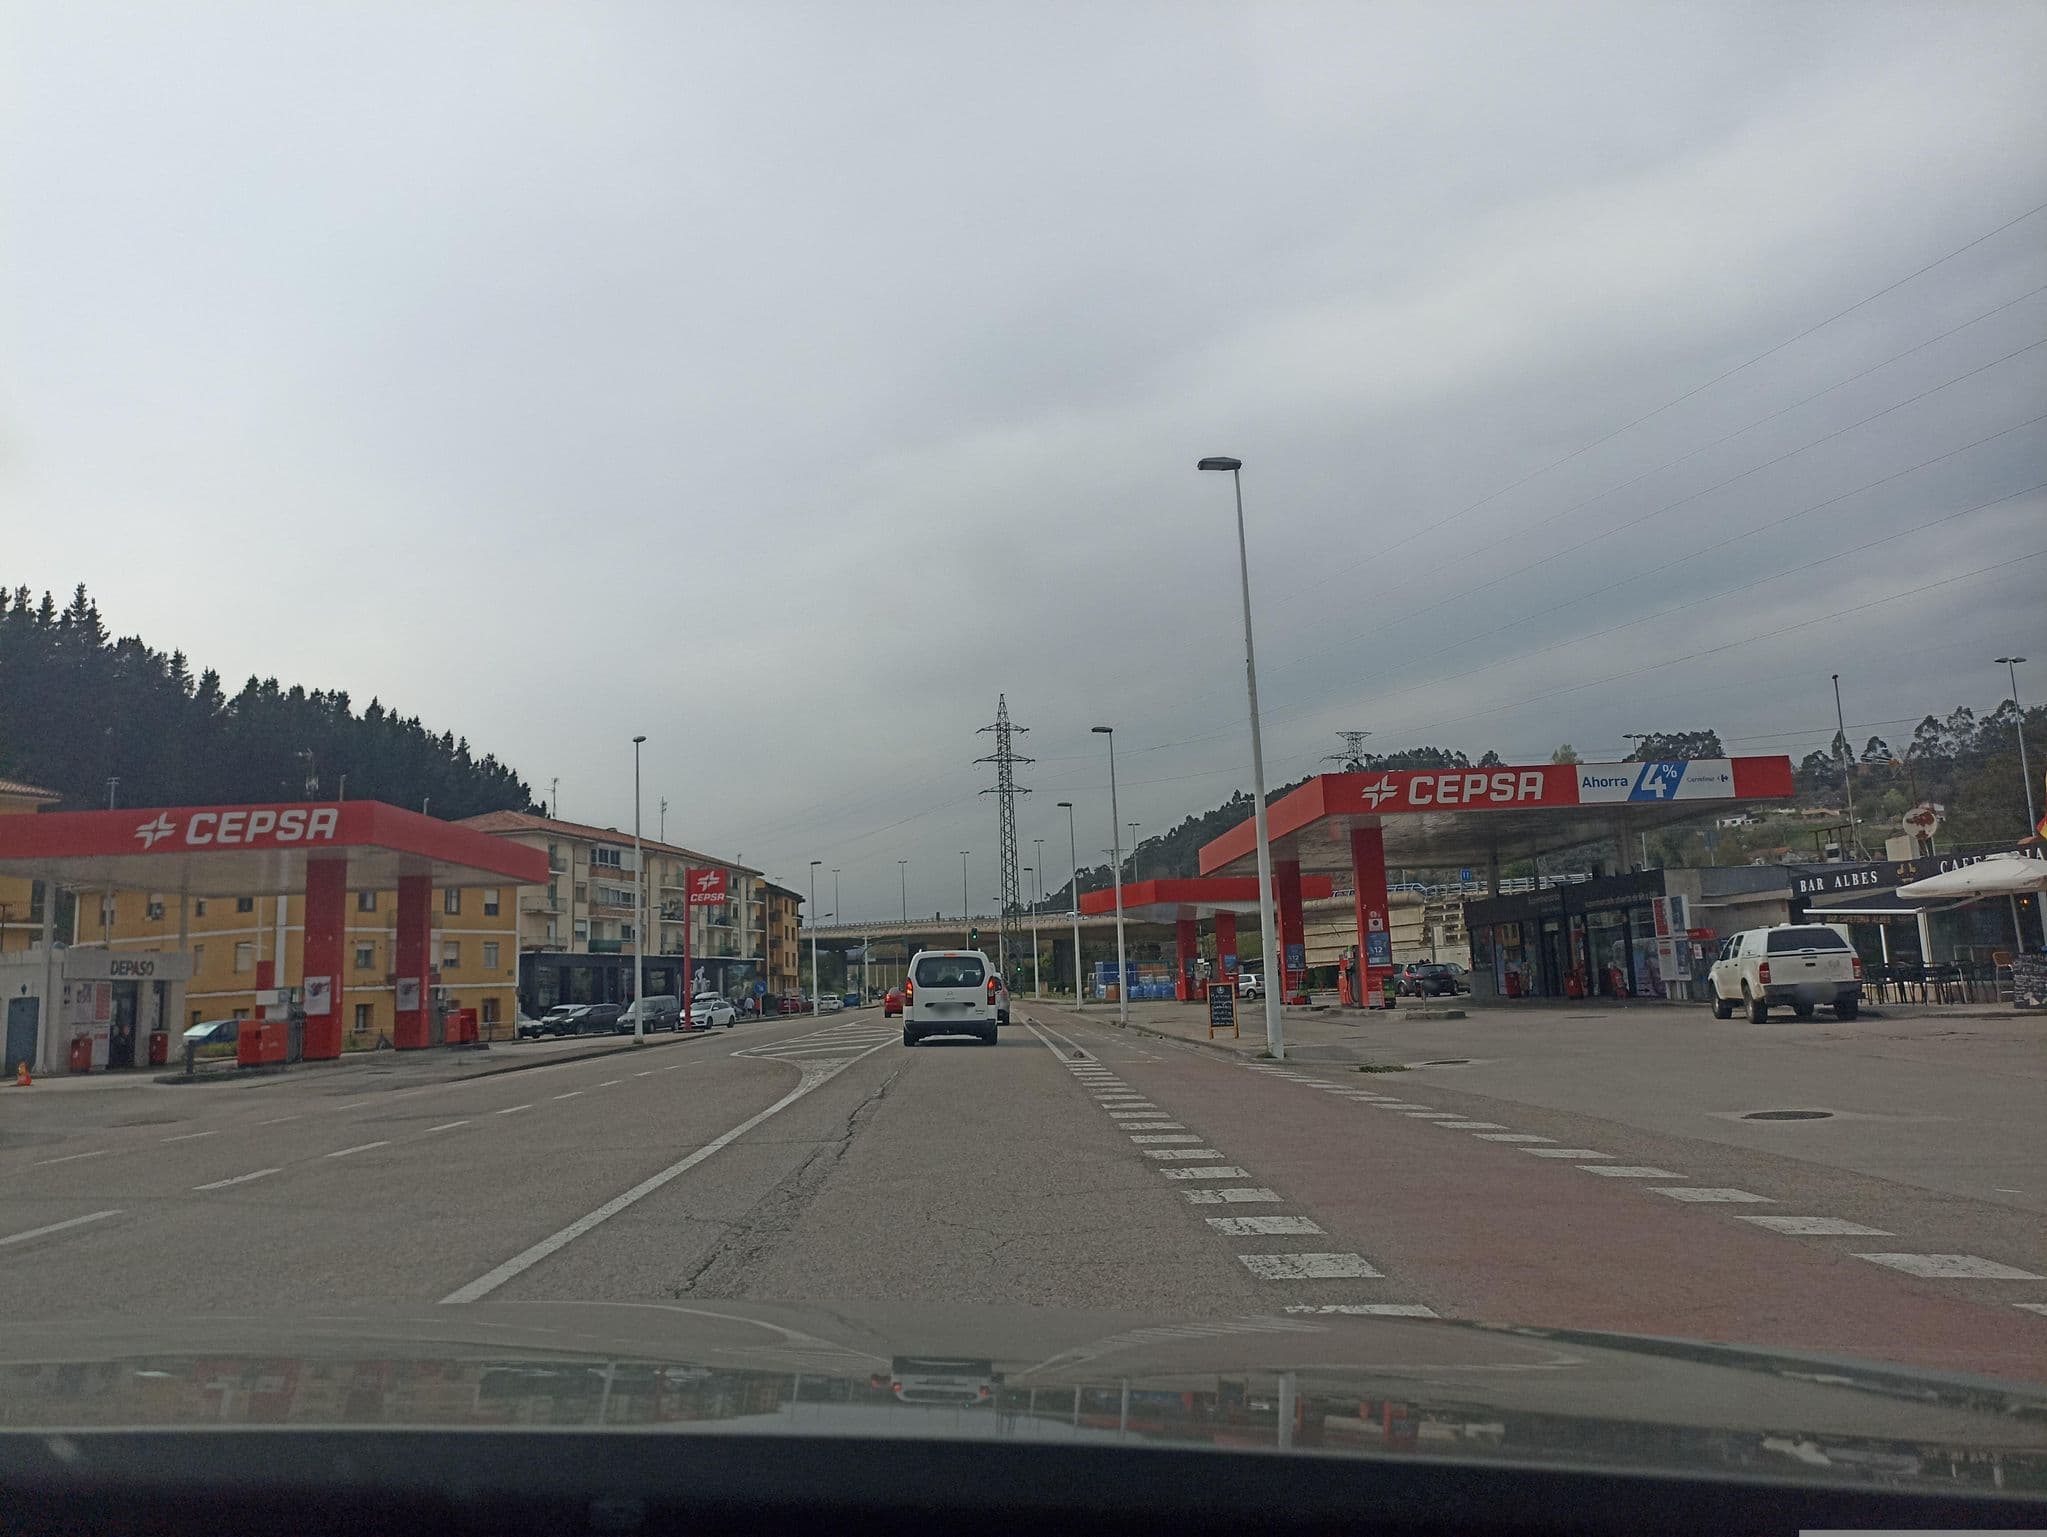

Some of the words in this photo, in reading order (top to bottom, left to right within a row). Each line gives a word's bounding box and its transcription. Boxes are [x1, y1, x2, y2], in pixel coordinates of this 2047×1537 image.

[1408, 771, 1544, 805] CEPSA
[1582, 776, 1629, 788] Ahorra
[185, 808, 339, 845] CEPSA
[1800, 879, 1825, 893] BAR
[1834, 871, 1878, 889] ALBES
[690, 893, 725, 902] CEPSA
[110, 960, 154, 976] DEPASO
